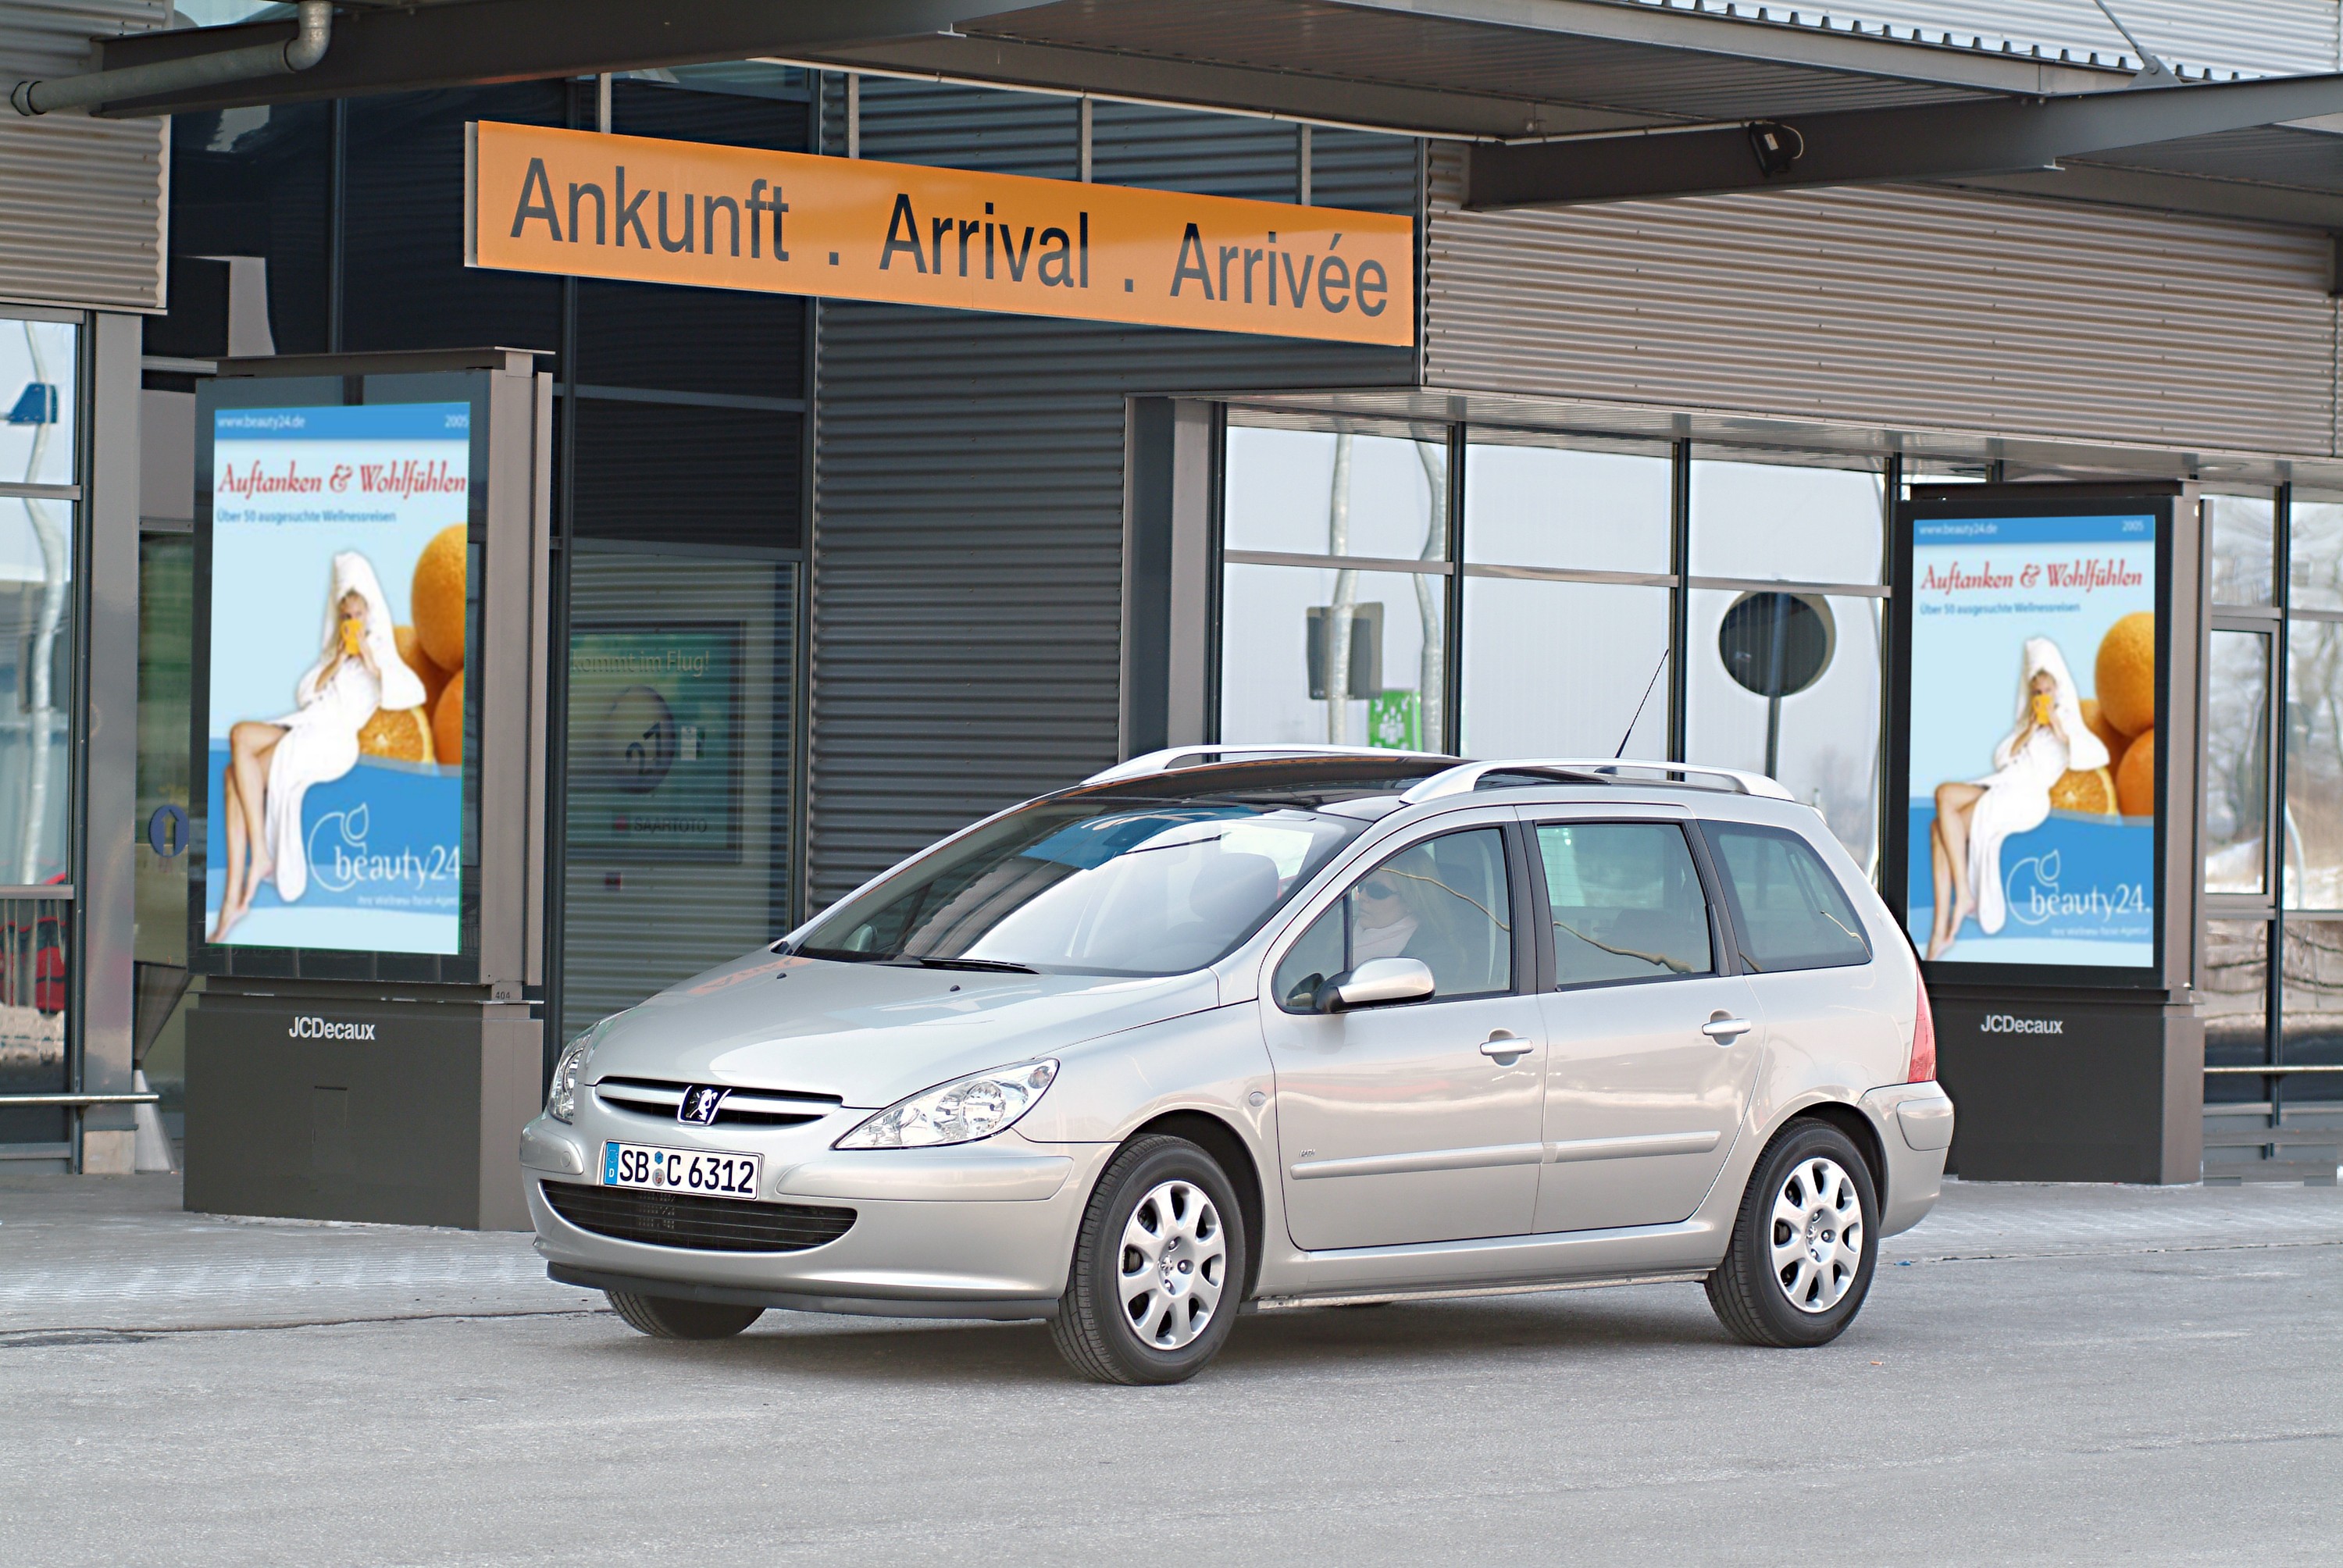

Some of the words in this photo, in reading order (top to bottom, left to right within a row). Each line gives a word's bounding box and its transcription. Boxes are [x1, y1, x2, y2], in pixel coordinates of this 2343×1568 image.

[510, 156, 790, 262] Ankunft
[879, 193, 1089, 289] Arrival
[1170, 223, 1389, 317] Arrivée
[216, 415, 306, 431] www.beauty24.de
[444, 414, 469, 429] 2005
[217, 459, 323, 500] Auftanken
[328, 464, 353, 494] &
[359, 459, 467, 500] Wohlfühlen
[216, 508, 242, 523] Über
[244, 510, 257, 523] 50
[258, 510, 321, 526] ausgesuchte
[322, 508, 397, 523] Wellnessreisen
[2121, 520, 2144, 533] 2005
[1918, 522, 1999, 536] www.beauty24.de
[1920, 561, 2014, 596] Auftanken
[2019, 563, 2042, 589] &
[2046, 558, 2143, 593] Wohlfühlen
[1920, 602, 1942, 615] Über
[1944, 603, 1956, 615] 50
[1957, 603, 2013, 617] ausgesuchte
[2013, 601, 2081, 615] Wellnessreisen
[639, 650, 662, 673] im
[666, 649, 711, 678] Flug!
[633, 817, 708, 833] SAARTOTO
[288, 1017, 376, 1041] JCDecaux
[1981, 1014, 2063, 1035] JCDecaux
[608, 1168, 615, 1178] D
[619, 1149, 649, 1184] SB
[666, 1154, 682, 1186] C
[688, 1156, 754, 1194] 6312
